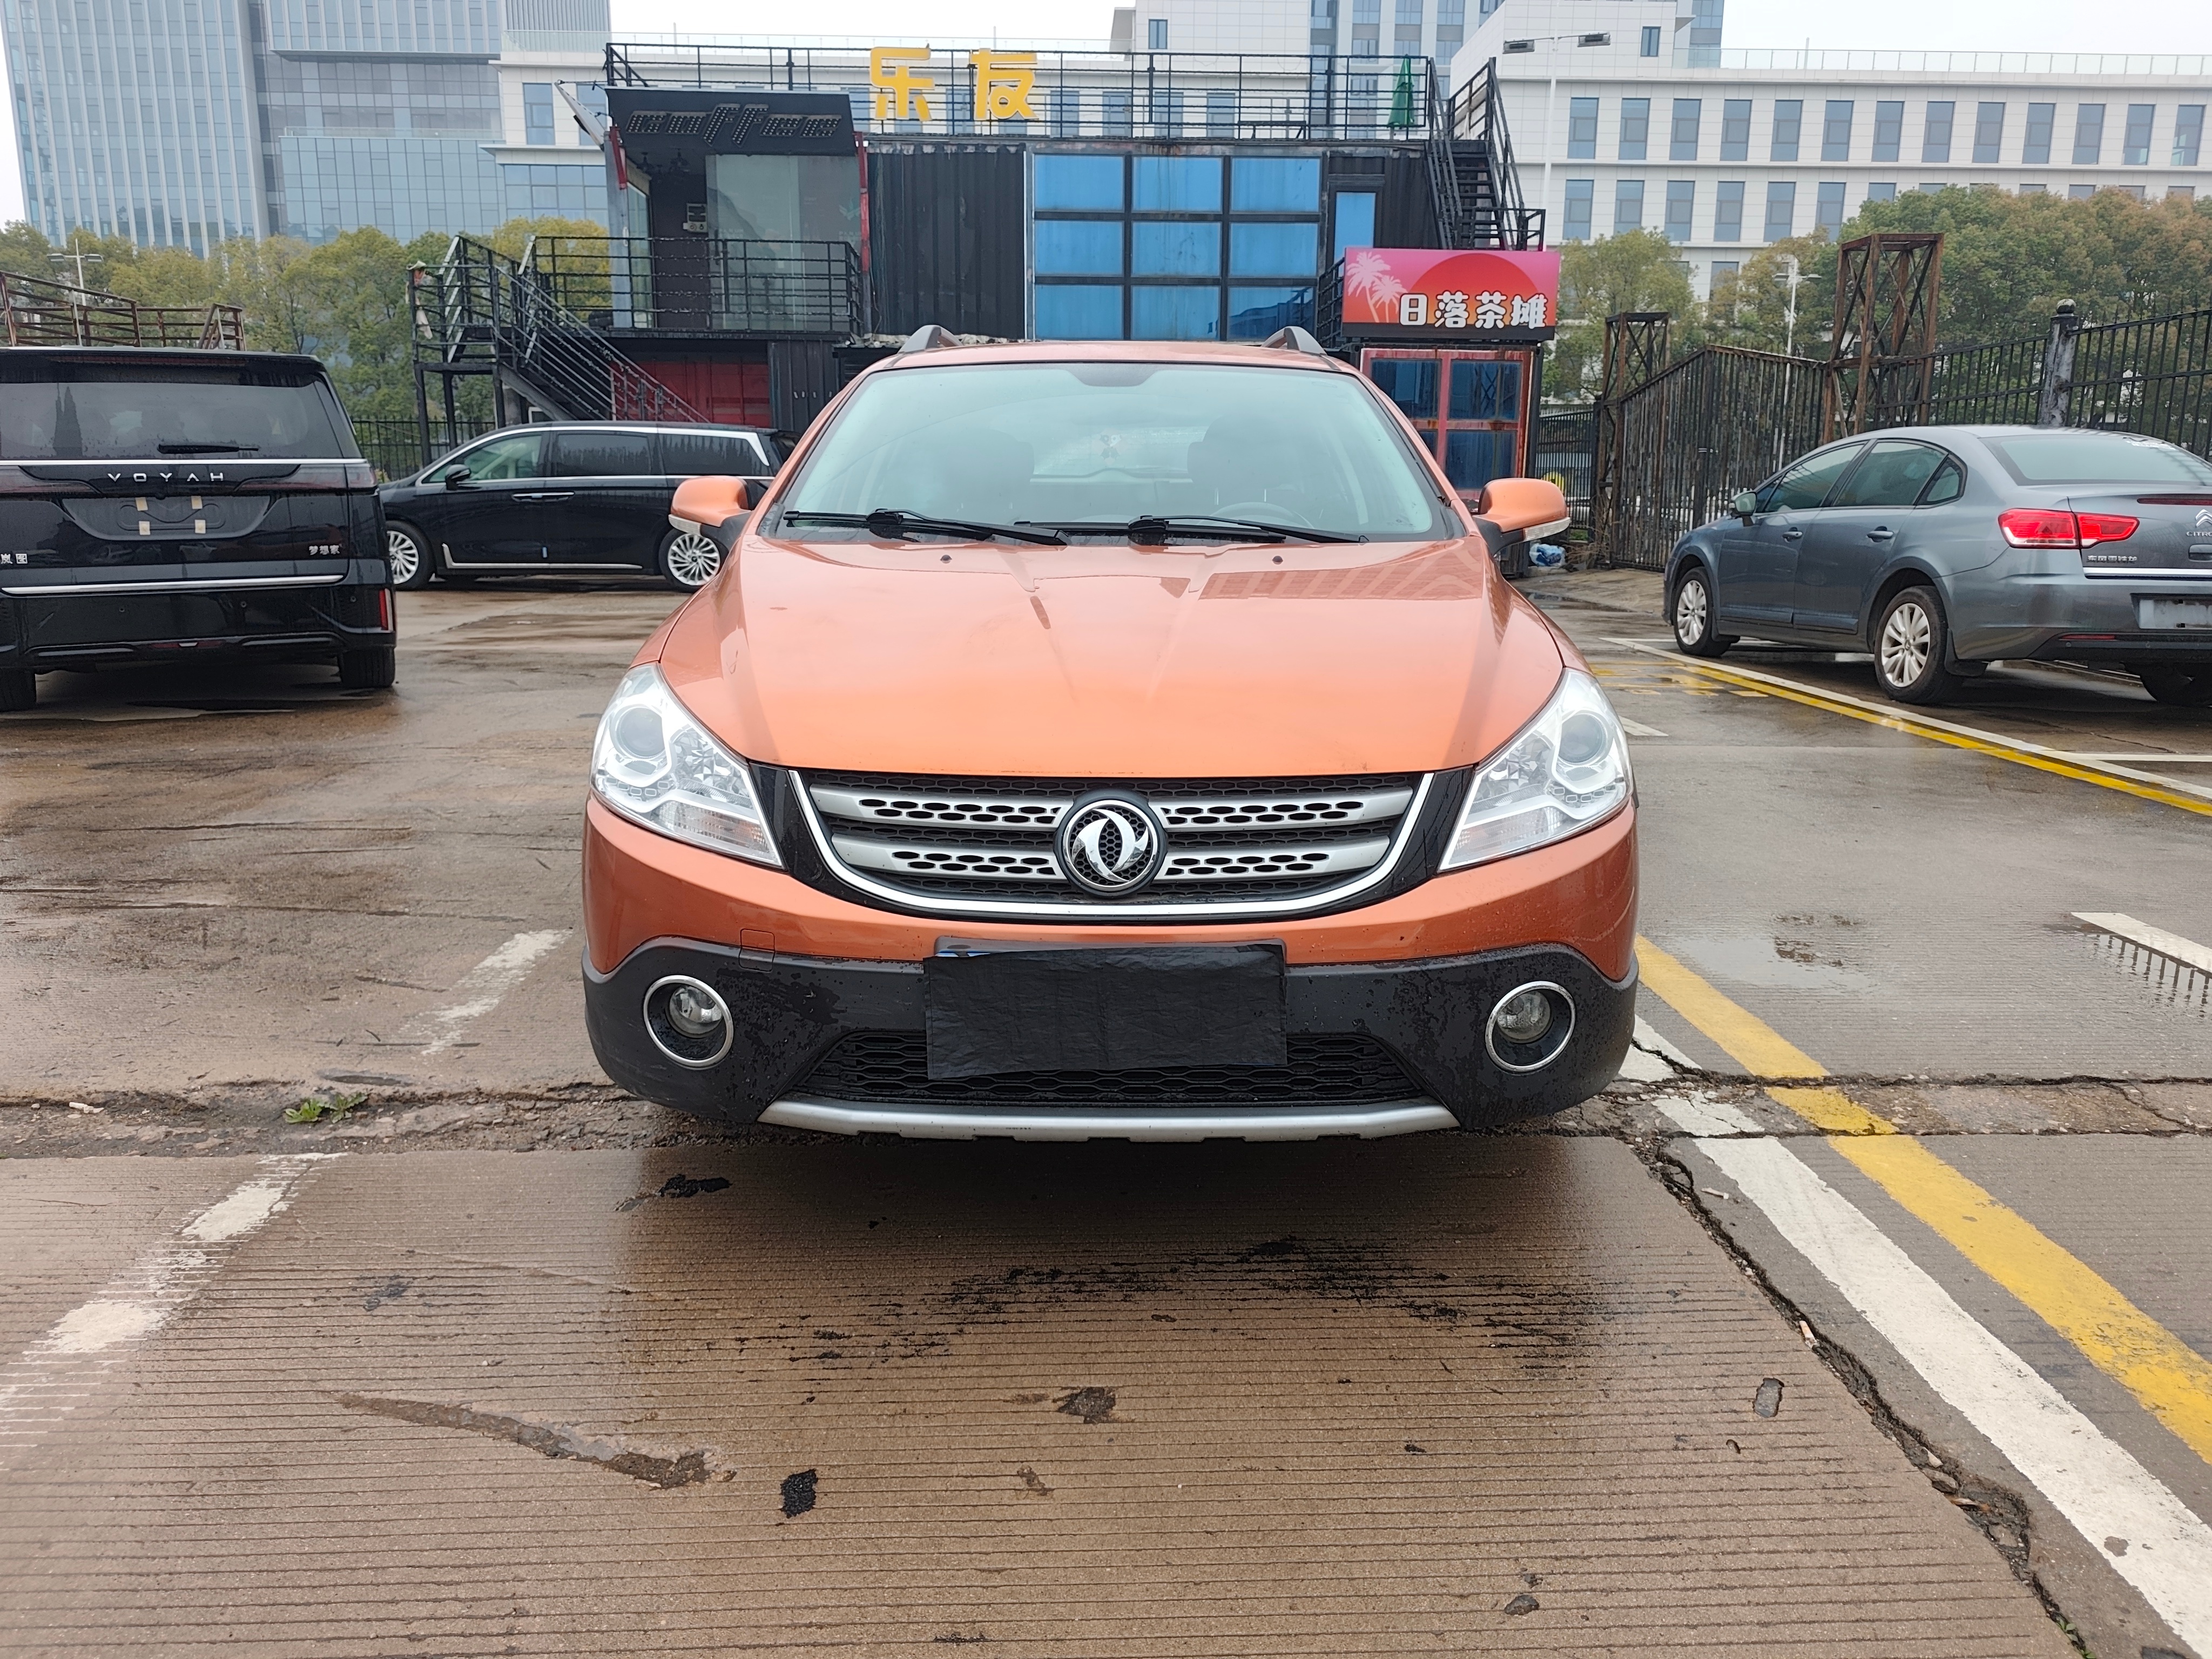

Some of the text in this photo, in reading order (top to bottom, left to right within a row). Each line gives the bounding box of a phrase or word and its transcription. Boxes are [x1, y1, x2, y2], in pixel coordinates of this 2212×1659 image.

[870, 47, 1039, 121] 乐友
[626, 103, 842, 147] coffee
[1399, 291, 1548, 329] 日落茶摊
[107, 472, 224, 482] VOYAH
[1, 553, 28, 564] 岚图
